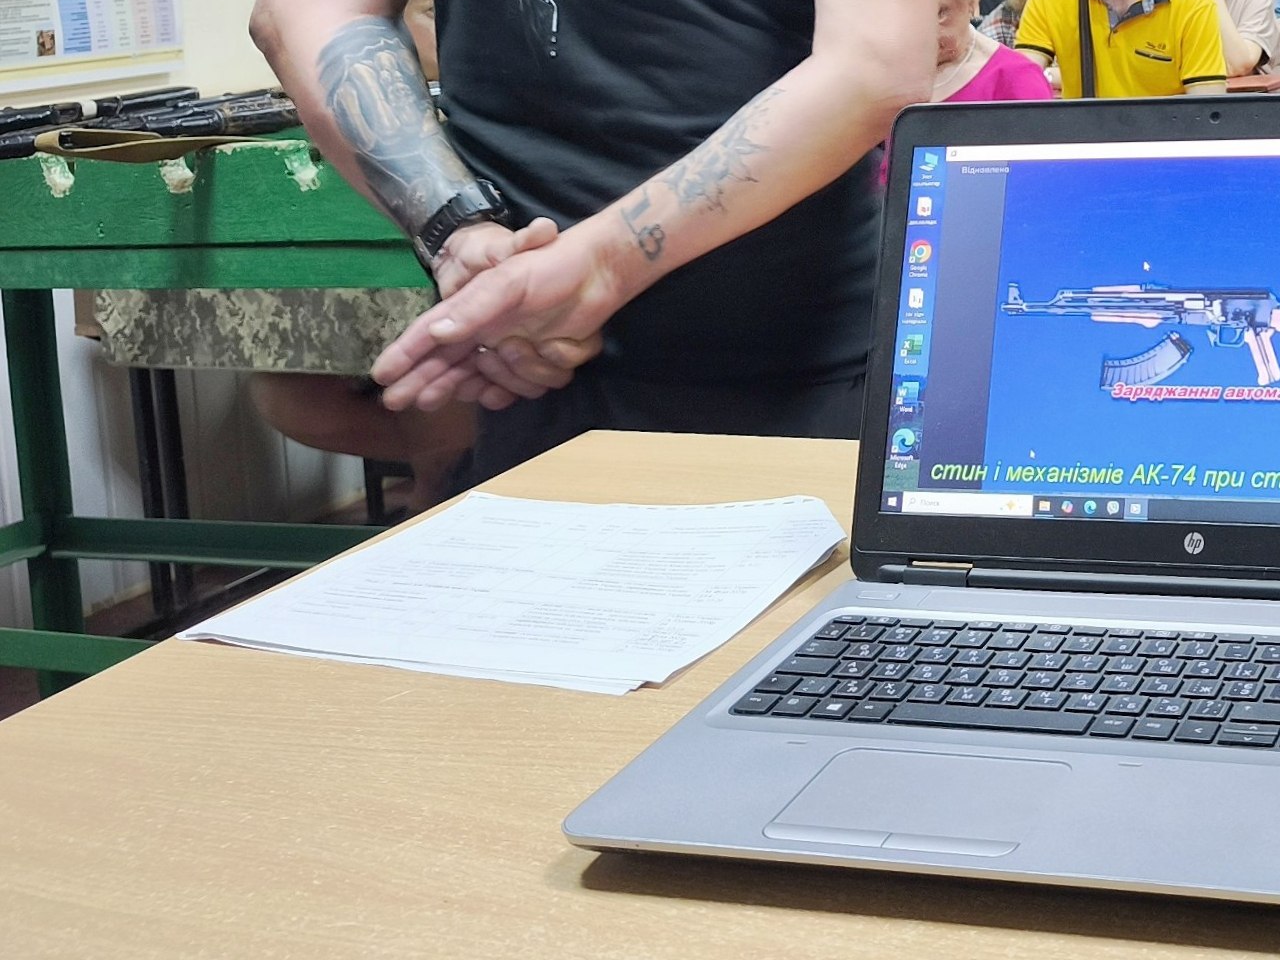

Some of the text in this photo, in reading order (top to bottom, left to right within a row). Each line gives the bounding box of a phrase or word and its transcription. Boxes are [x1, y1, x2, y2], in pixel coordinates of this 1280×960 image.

[961, 166, 1010, 175] Відновлено
[1112, 383, 1221, 401] Заряджання
[931, 462, 988, 481] стин
[993, 461, 1002, 481] і
[1005, 462, 1124, 485] механізмів
[1130, 463, 1197, 487] АК-74
[1203, 472, 1244, 492] при
[1184, 532, 1205, 555] hp
